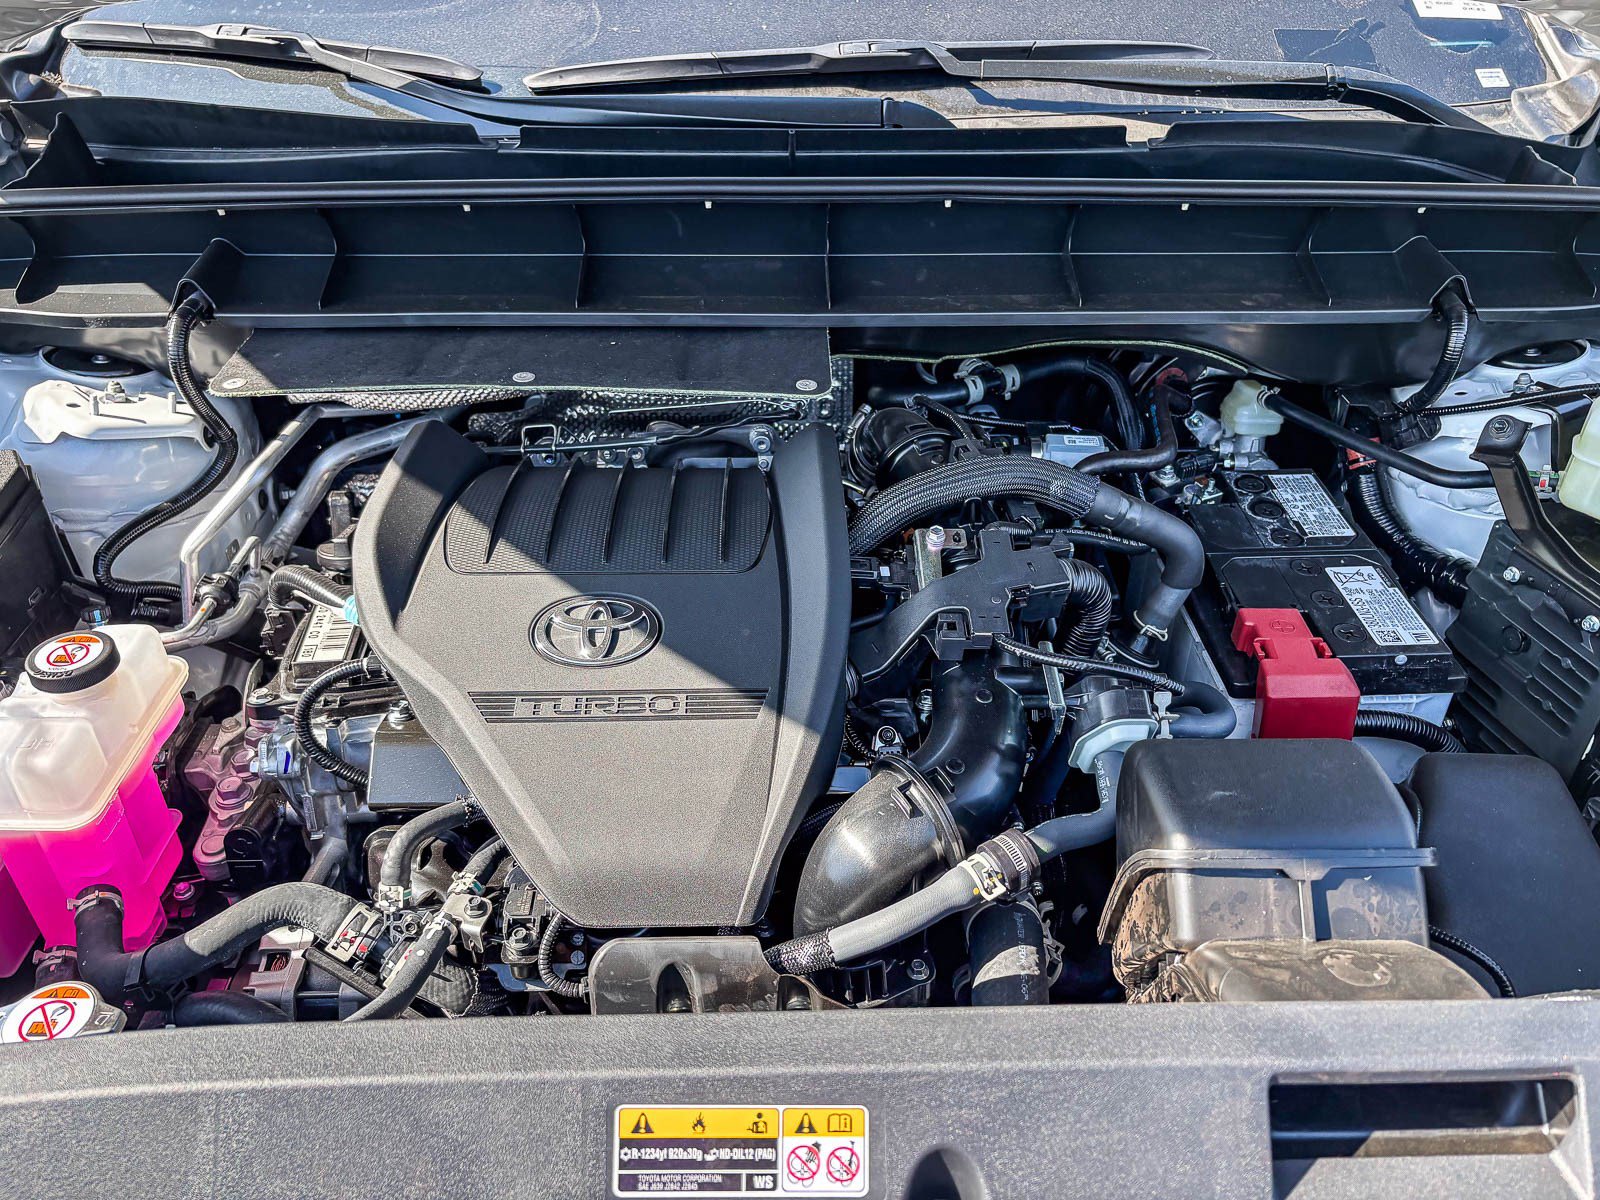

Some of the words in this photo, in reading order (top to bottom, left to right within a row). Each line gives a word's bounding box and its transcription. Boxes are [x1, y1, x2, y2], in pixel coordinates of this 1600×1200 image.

[520, 695, 681, 716] TURBO
[755, 1147, 777, 1162] (PAG)
[638, 1174, 661, 1182] TOYOTA
[660, 1174, 682, 1182] MOTOR
[682, 1174, 722, 1183] CORPORATION
[752, 1174, 774, 1189] WS
[638, 1182, 650, 1191] SAE
